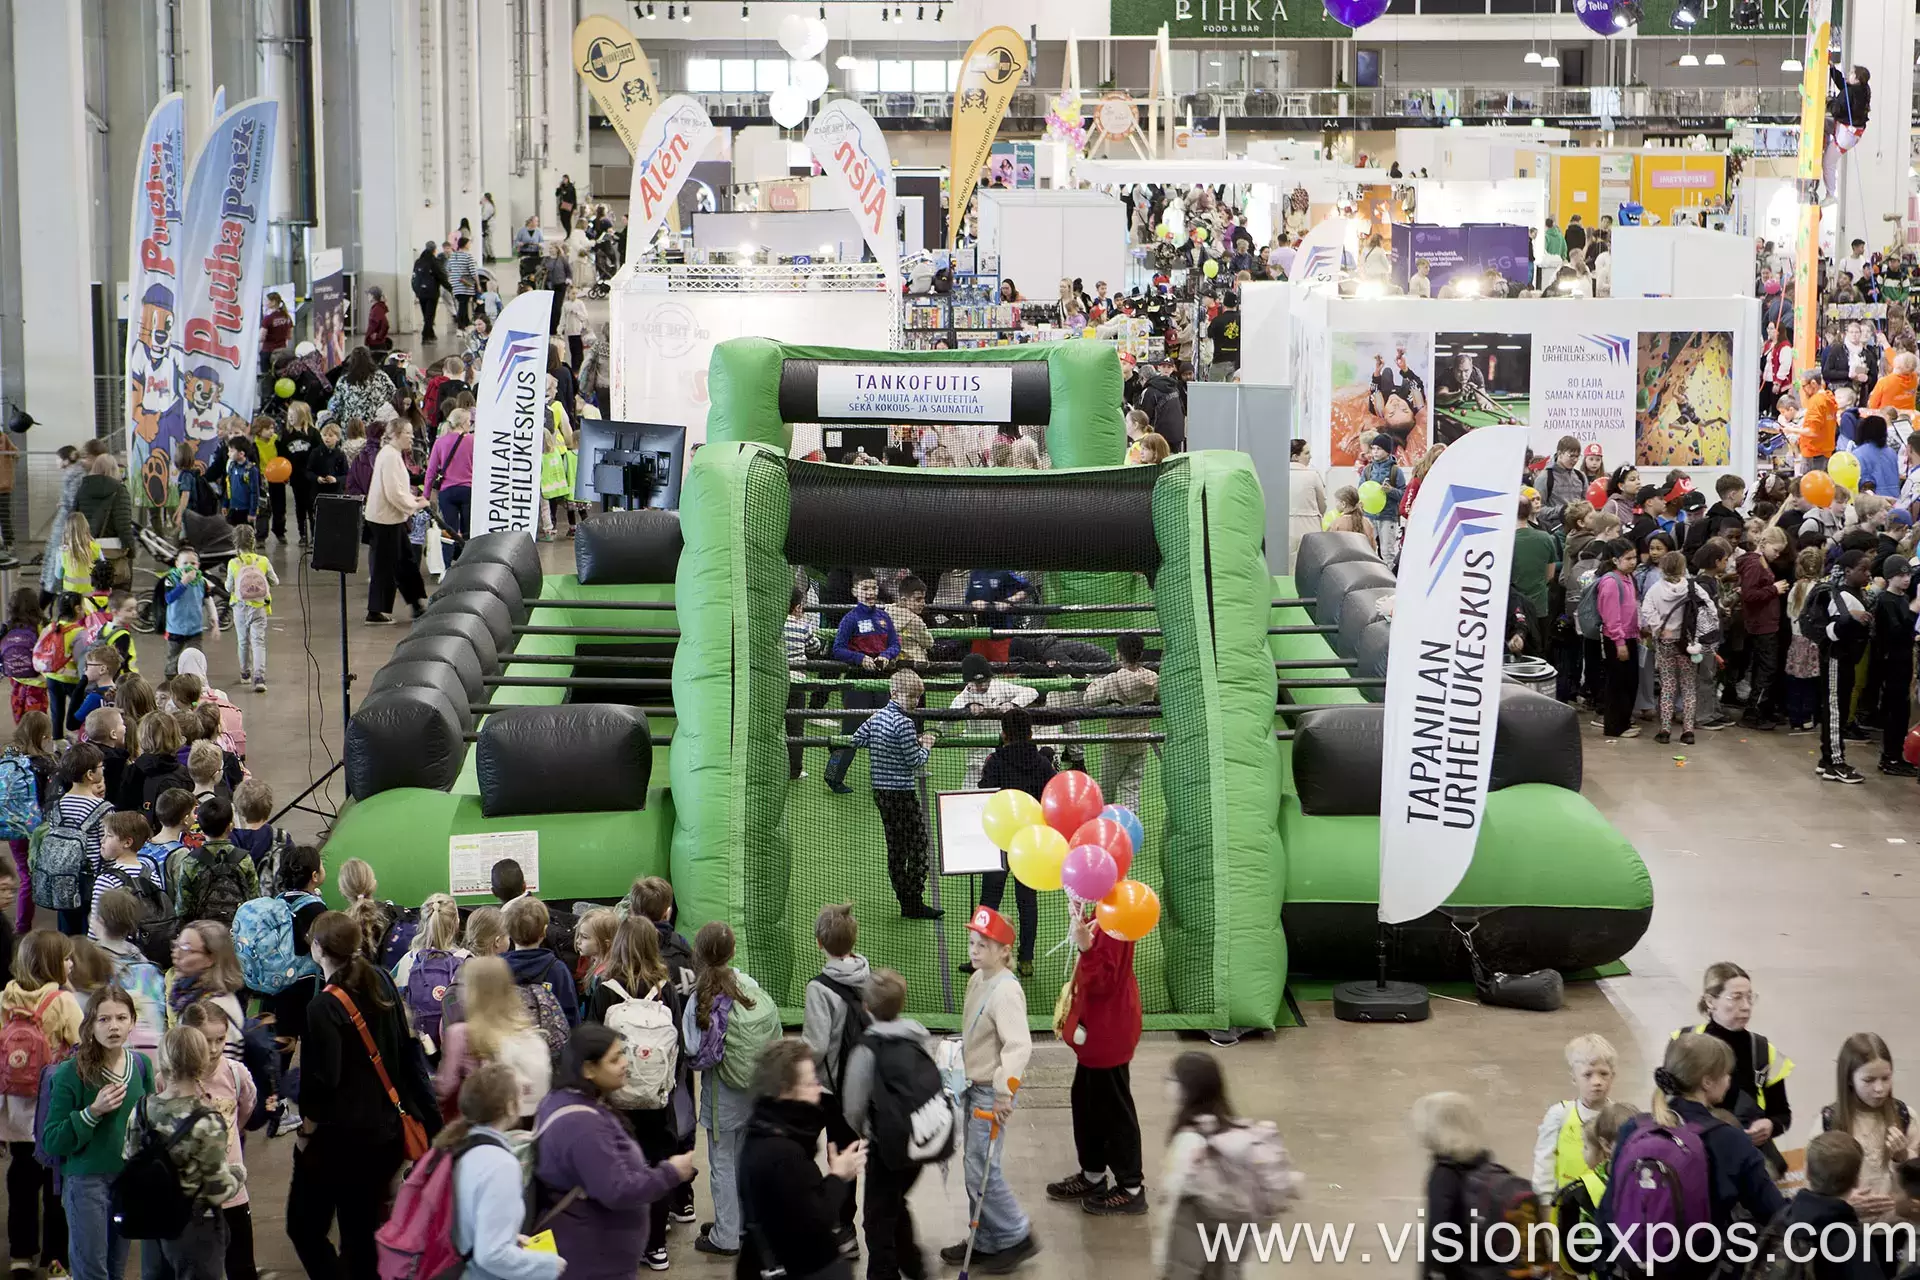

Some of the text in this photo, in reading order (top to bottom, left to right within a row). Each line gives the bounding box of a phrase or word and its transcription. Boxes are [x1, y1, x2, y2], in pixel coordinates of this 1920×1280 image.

[1587, 0, 1609, 11] Telia
[1203, 25, 1260, 33] FOOD & BAR
[1768, 22, 1787, 30] BAR
[639, 133, 690, 221] Alén
[1487, 255, 1512, 270] 5G
[1542, 345, 1585, 354] TAPANILAN
[1542, 353, 1607, 363] URHEILUKESKUS
[855, 374, 981, 392] TANKOFUTIS
[1567, 377, 1603, 388] 80 LAJIA
[878, 394, 910, 403] MUUTA
[913, 394, 978, 404] AKTIVITEETTIA
[1545, 390, 1625, 401] SAMAN KATON ALLA
[875, 403, 915, 412] KOKOUS-
[918, 404, 928, 413] JA
[930, 405, 984, 414] SAUNATILAT
[1547, 407, 1622, 417] VAIN 13 MINUUTIN
[1543, 420, 1592, 430] AJOMATKAN
[511, 370, 536, 532] RHEILUKESKUS
[1443, 547, 1495, 831] URHEILUKESKUS
[1407, 639, 1452, 825] TAPANILAN
